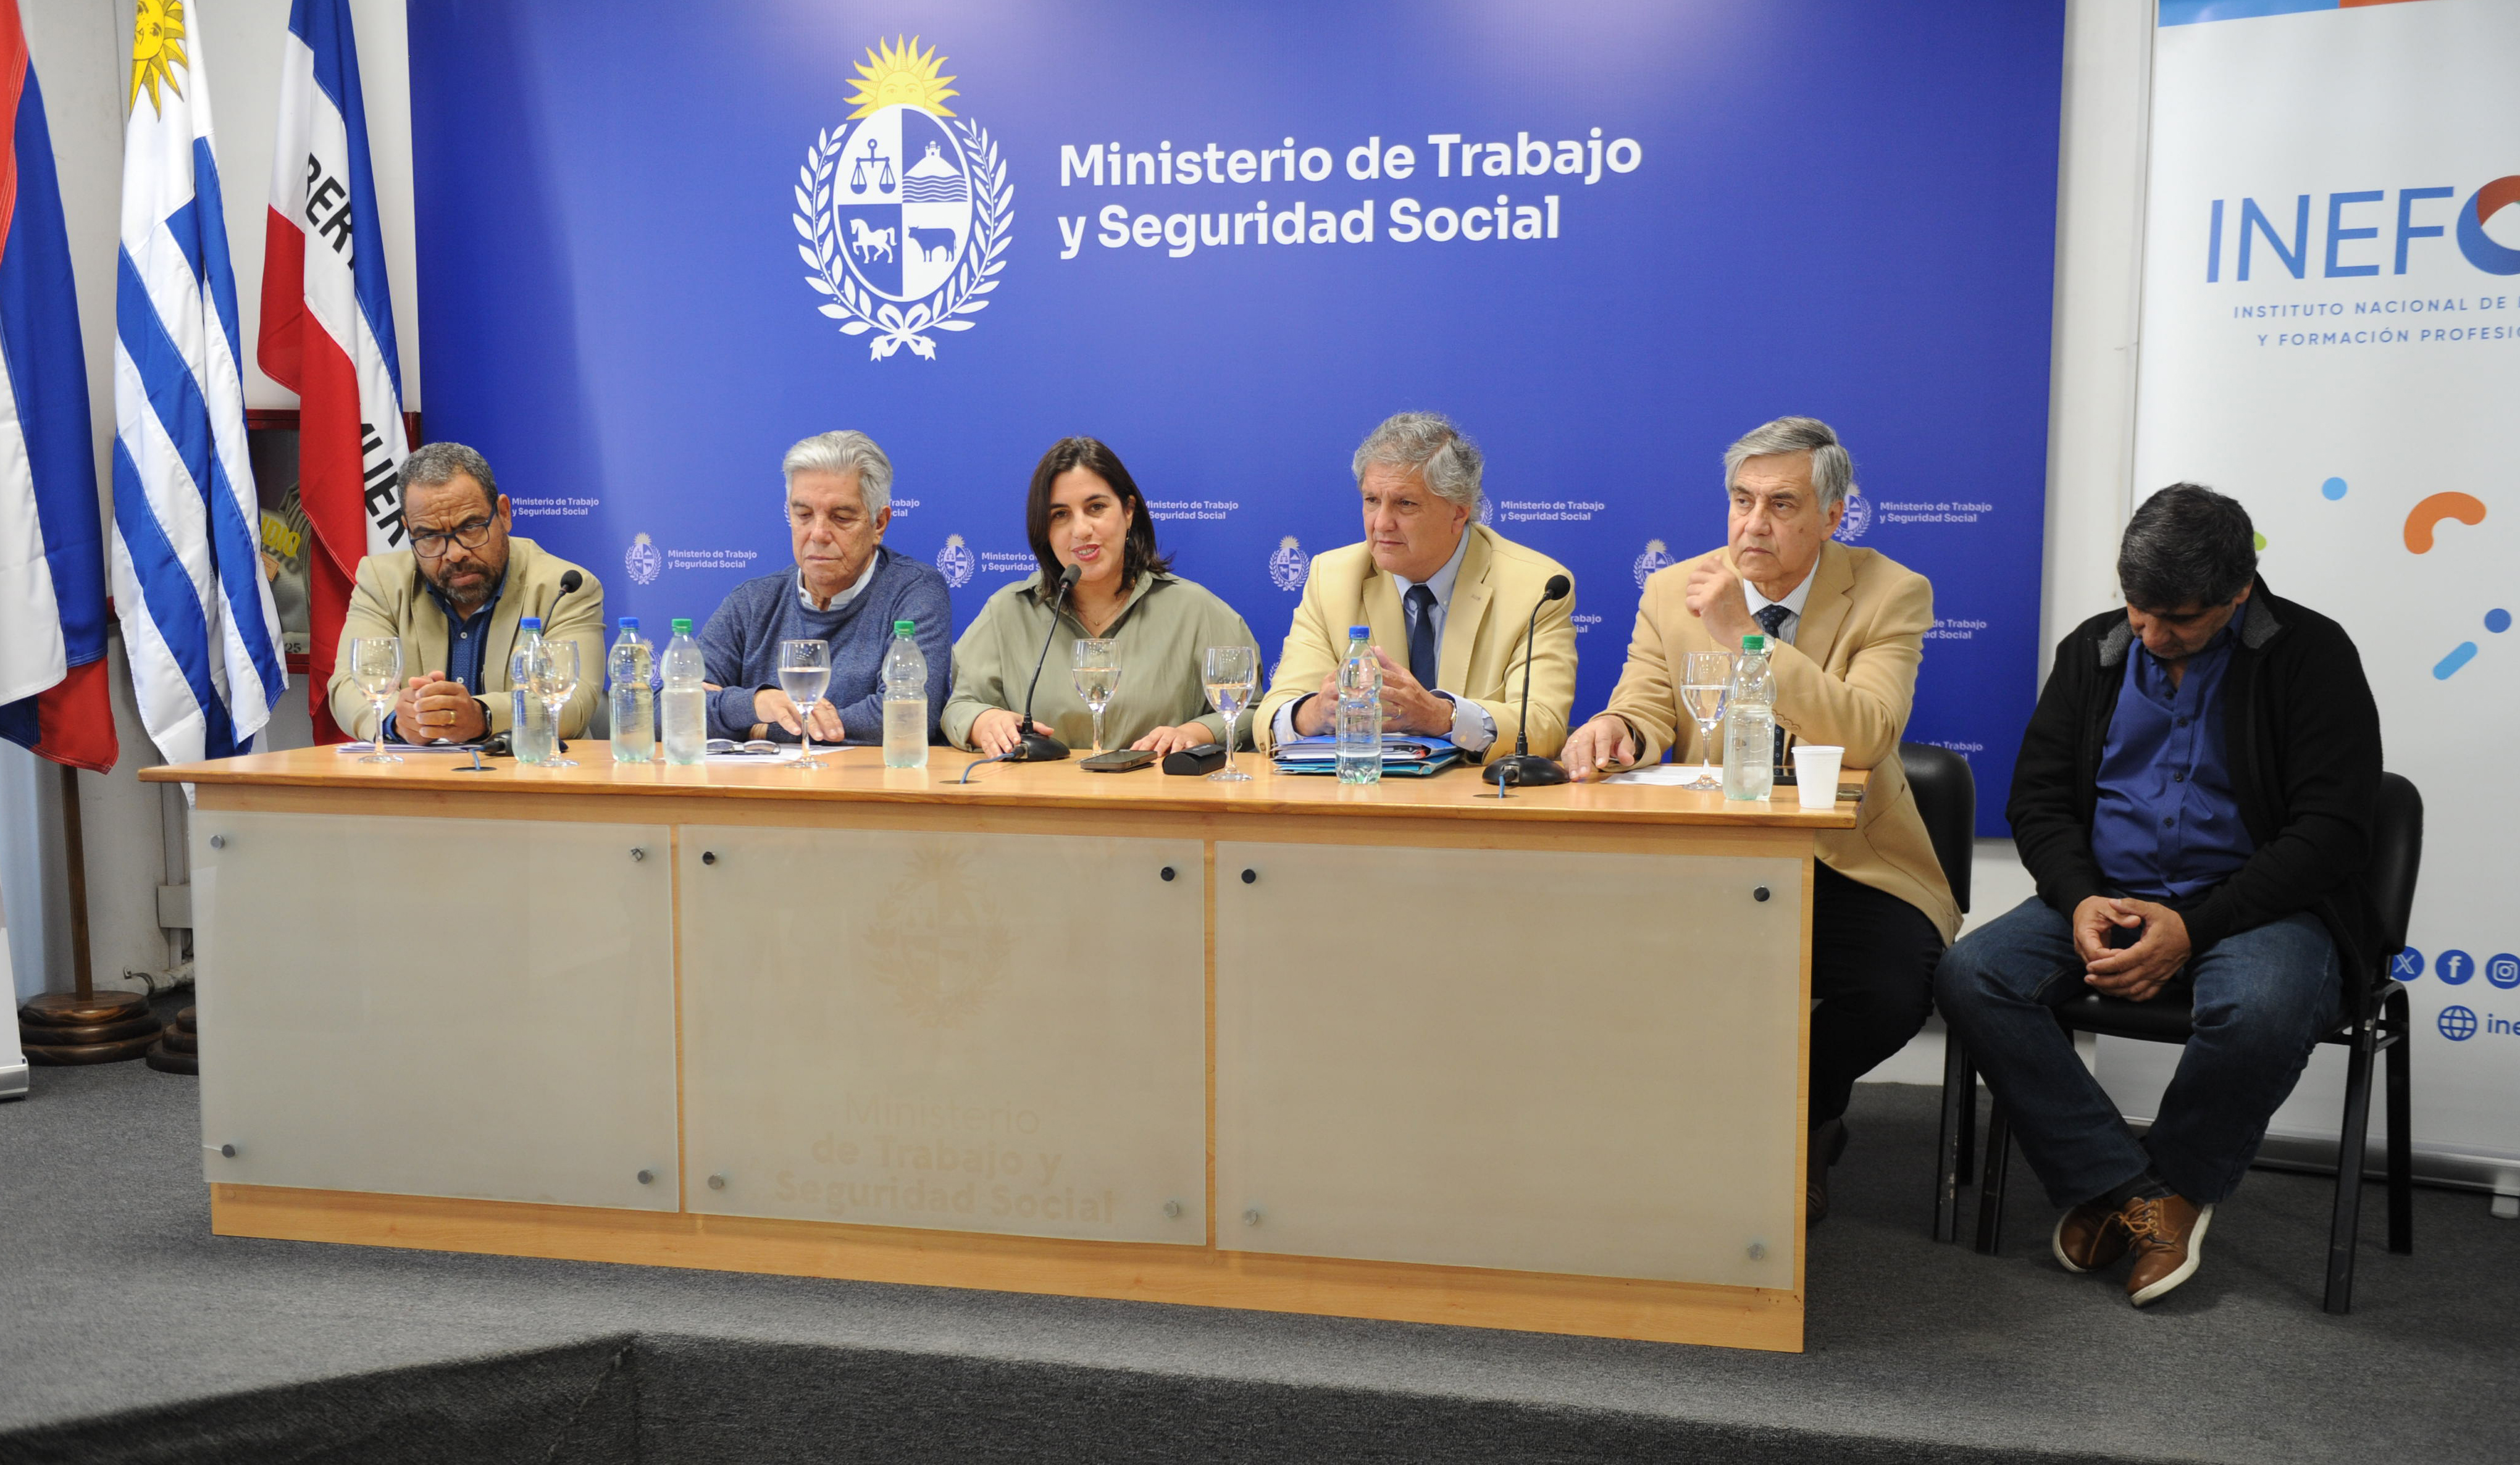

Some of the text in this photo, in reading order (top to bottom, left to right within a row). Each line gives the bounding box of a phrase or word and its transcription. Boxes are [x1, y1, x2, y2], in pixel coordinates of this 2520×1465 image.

[1061, 127, 1642, 186] Ministerio de Trabajo
[1058, 194, 1559, 259] y Seguridad Social
[2234, 303, 2343, 319] INSTITUTO
[2355, 298, 2468, 314] NACIONAL
[2480, 296, 2506, 309] DE
[2258, 326, 2520, 346] Y FORMACIÓN PROFESI
[512, 497, 599, 507] Ministerio de Trabajo
[1190, 501, 1202, 509] de
[1203, 501, 1239, 511] Trabajo
[1501, 501, 1605, 511] Ministerio de Trabajo
[512, 507, 588, 517] y Seguridad Social
[1880, 502, 1992, 513] Ministerio de Trabajo
[891, 509, 908, 517] cial
[1149, 511, 1226, 520] Seguridad Social
[1501, 512, 1591, 522] y Seguridad Social
[1879, 513, 1977, 524] y Seguridad Social
[668, 549, 758, 559] Ministerio de Trabajo
[981, 552, 1028, 561] Ministerio
[668, 560, 745, 569] y Seguridad Social
[981, 564, 987, 572] y
[988, 562, 1034, 572] Seguridad
[1570, 614, 1602, 624] rabajo
[1946, 619, 1986, 630] Trabajo
[1939, 630, 1972, 639] Social
[846, 1091, 1040, 1135] Ministerio
[811, 1131, 1063, 1187] de Trabajo y
[776, 1170, 1115, 1224] Seguridad Social
